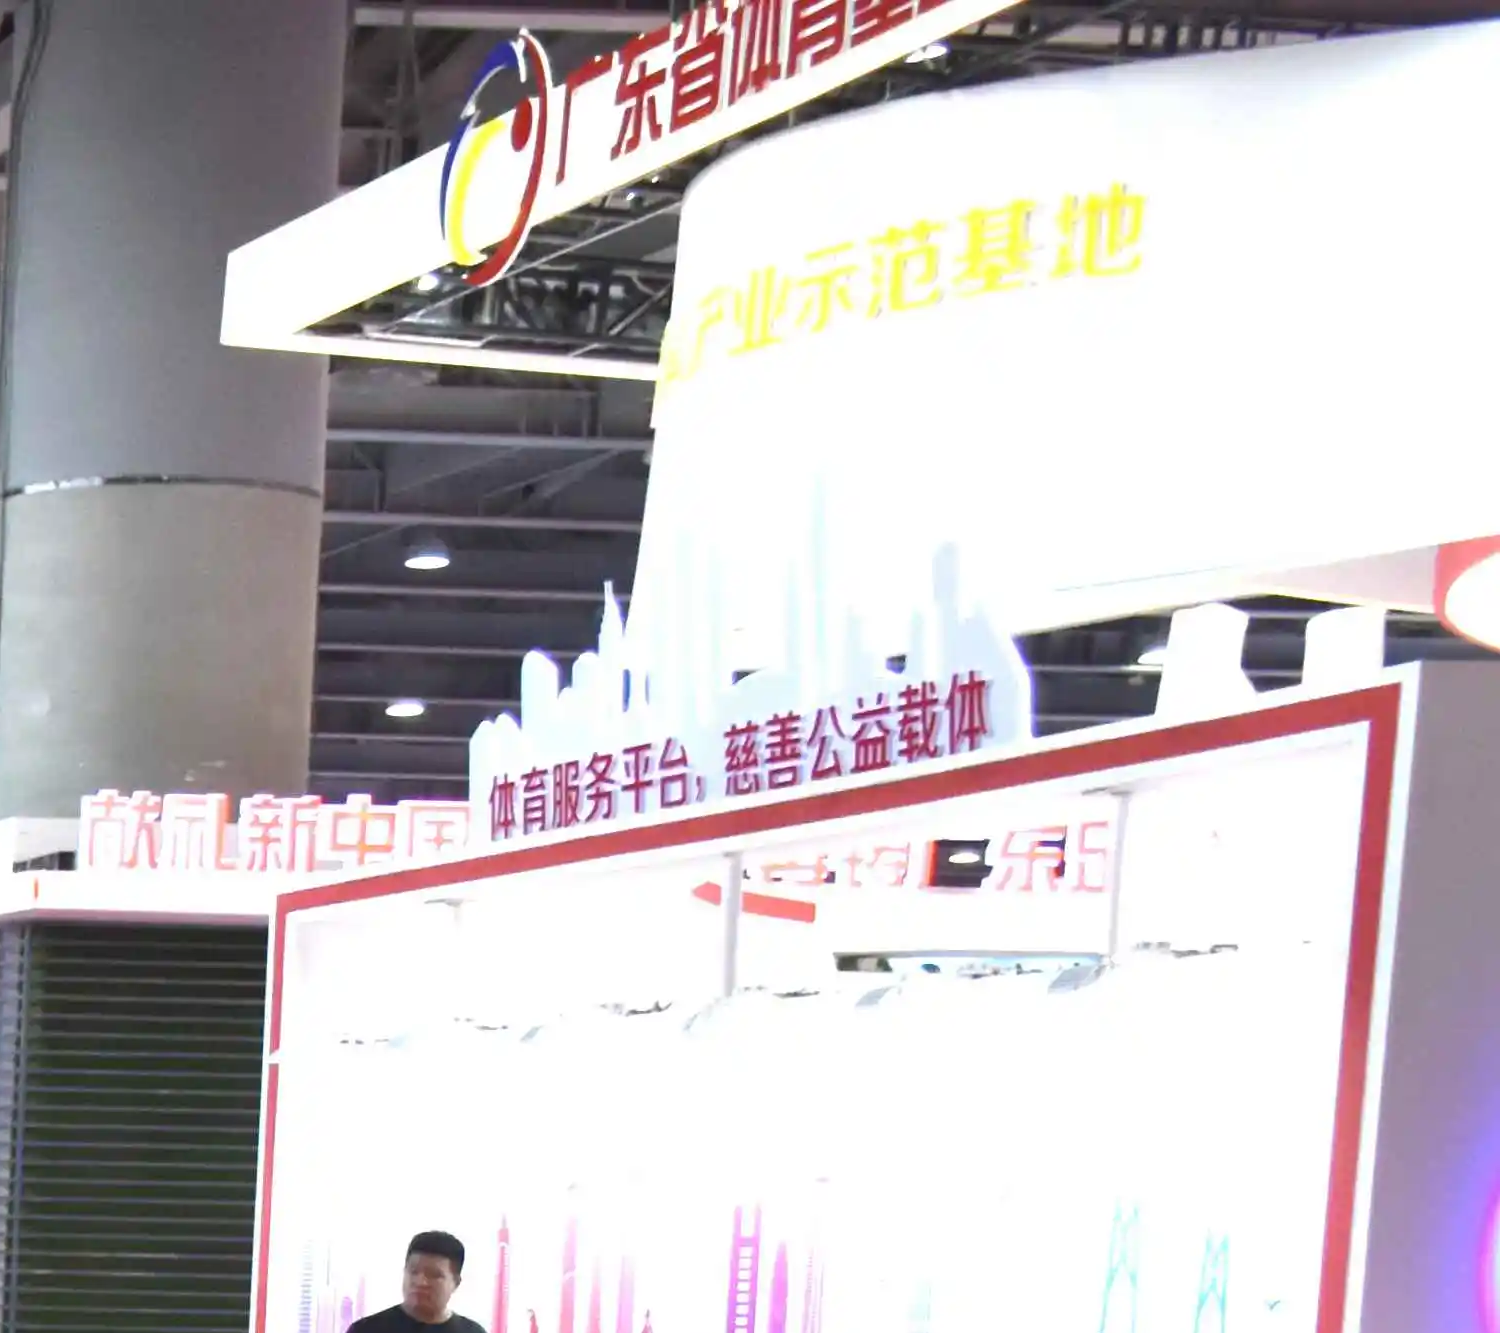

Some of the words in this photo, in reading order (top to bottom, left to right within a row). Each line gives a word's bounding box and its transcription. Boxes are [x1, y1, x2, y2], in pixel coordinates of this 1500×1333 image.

[556, 0, 948, 186] 广东省体育
